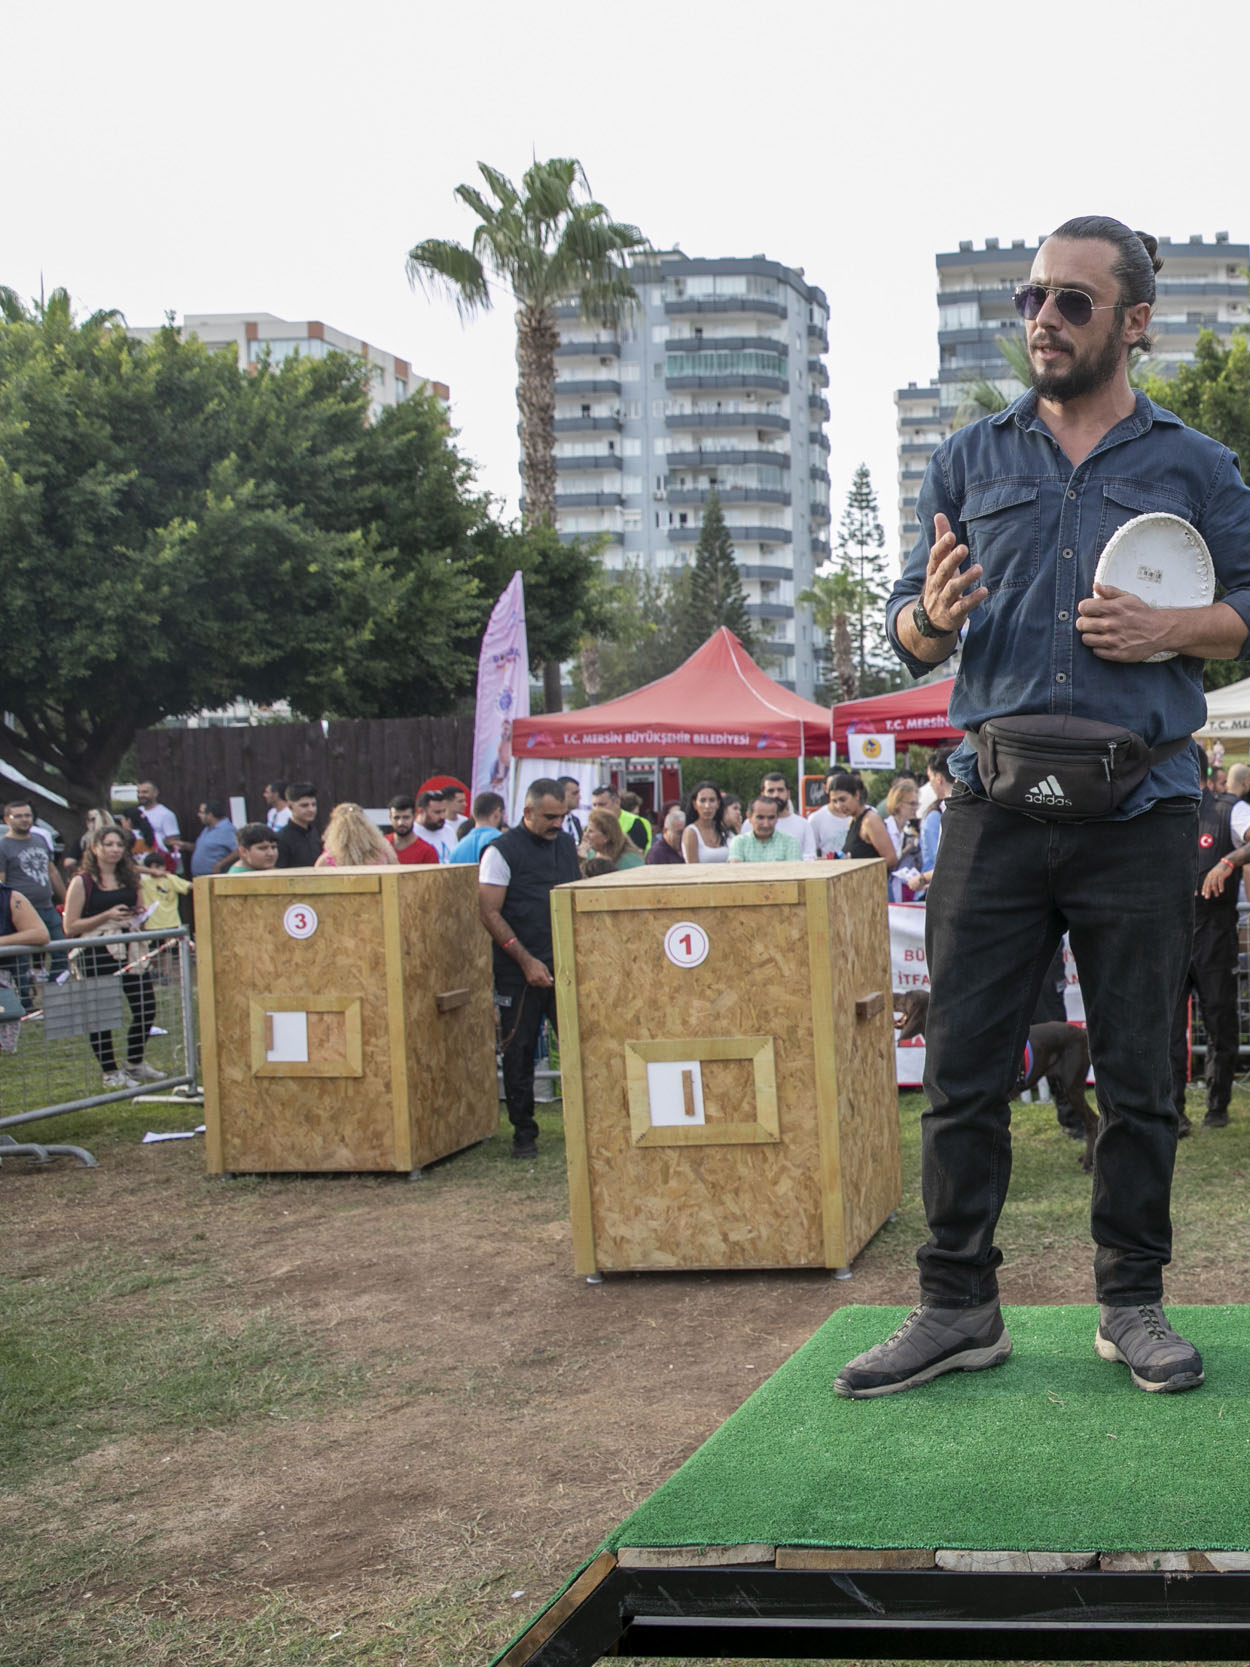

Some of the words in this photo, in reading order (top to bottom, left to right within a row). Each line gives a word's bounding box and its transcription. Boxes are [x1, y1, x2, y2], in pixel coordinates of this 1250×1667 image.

[886, 720, 905, 730] T.C.
[1210, 721, 1229, 731] T.C.
[563, 734, 581, 744] T.C.
[583, 731, 622, 744] MERSİN
[624, 730, 690, 746] BÜYÜKŞEHİR
[693, 731, 750, 745] BELEDİYESİ
[1024, 794, 1073, 806] adidas
[295, 913, 307, 930] 3
[679, 933, 692, 955] 1
[898, 971, 931, 985] İTFA
